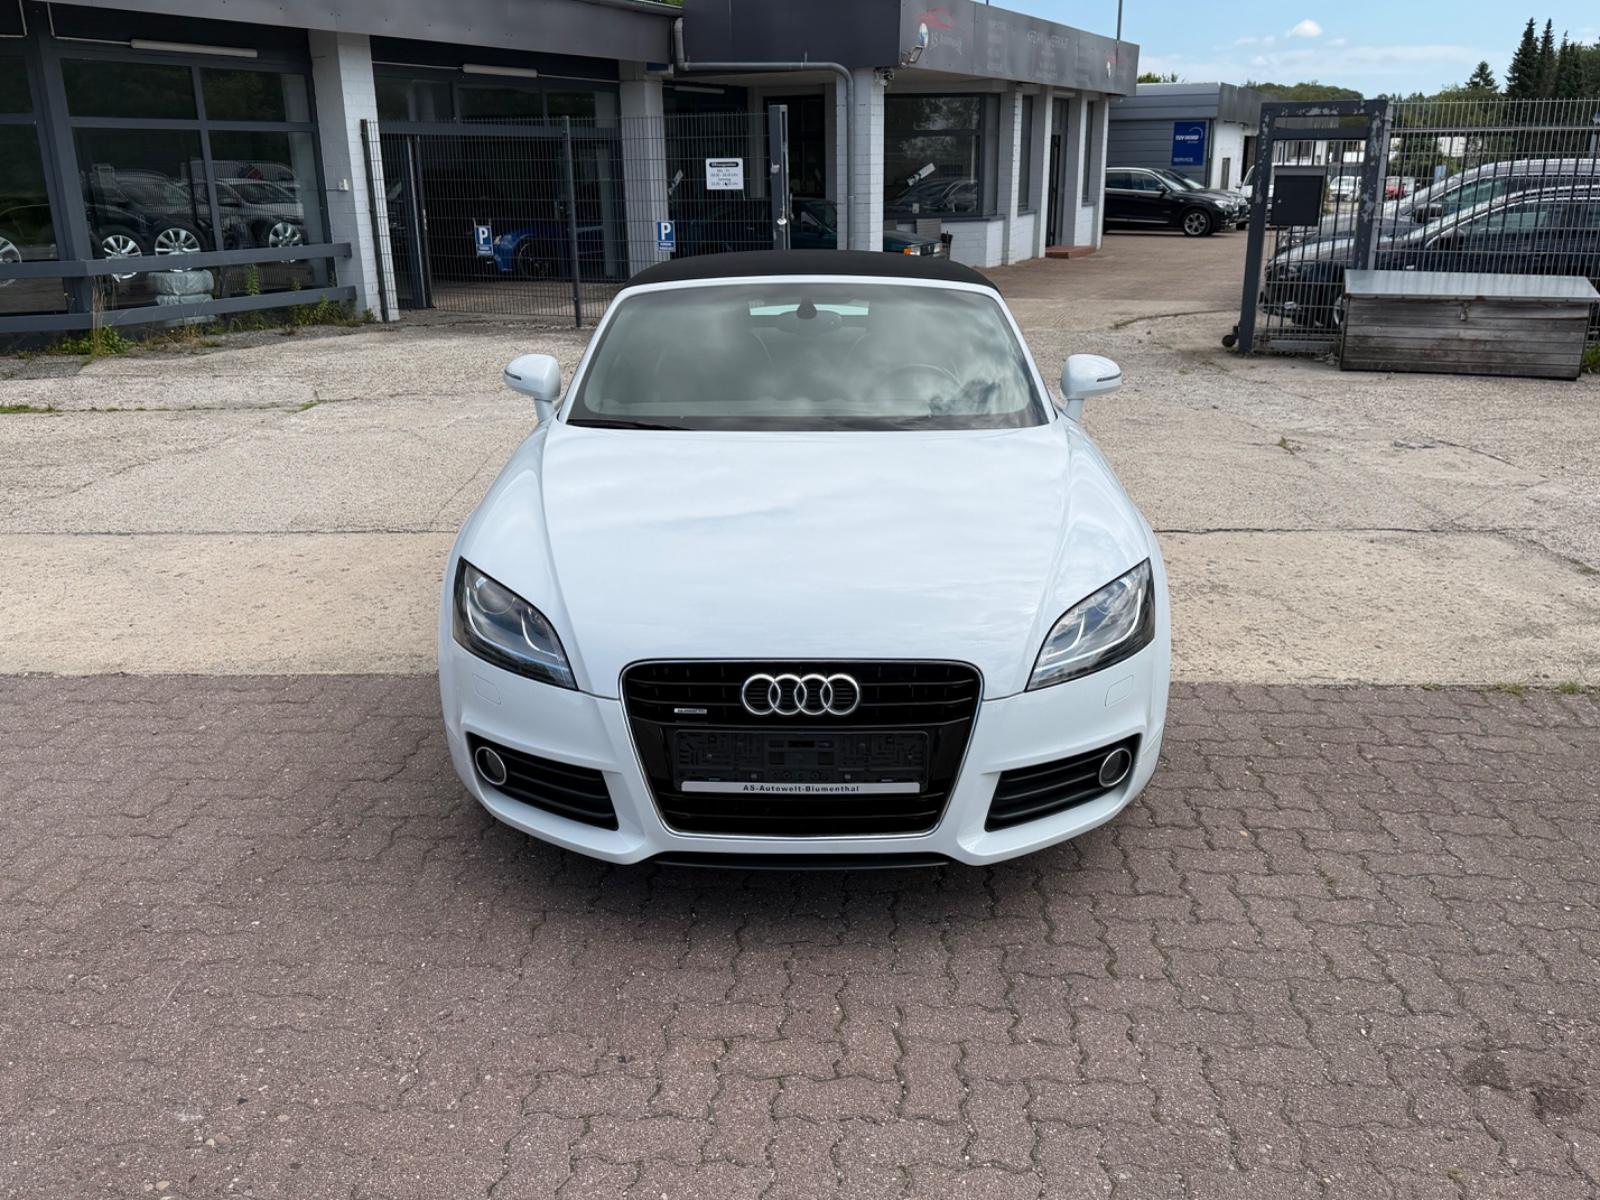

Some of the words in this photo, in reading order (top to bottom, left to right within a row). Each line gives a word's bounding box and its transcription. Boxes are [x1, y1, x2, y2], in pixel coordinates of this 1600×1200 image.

[478, 227, 488, 245] P
[661, 222, 671, 240] P
[743, 784, 860, 793] AS-Autowelt-Blumenthal
